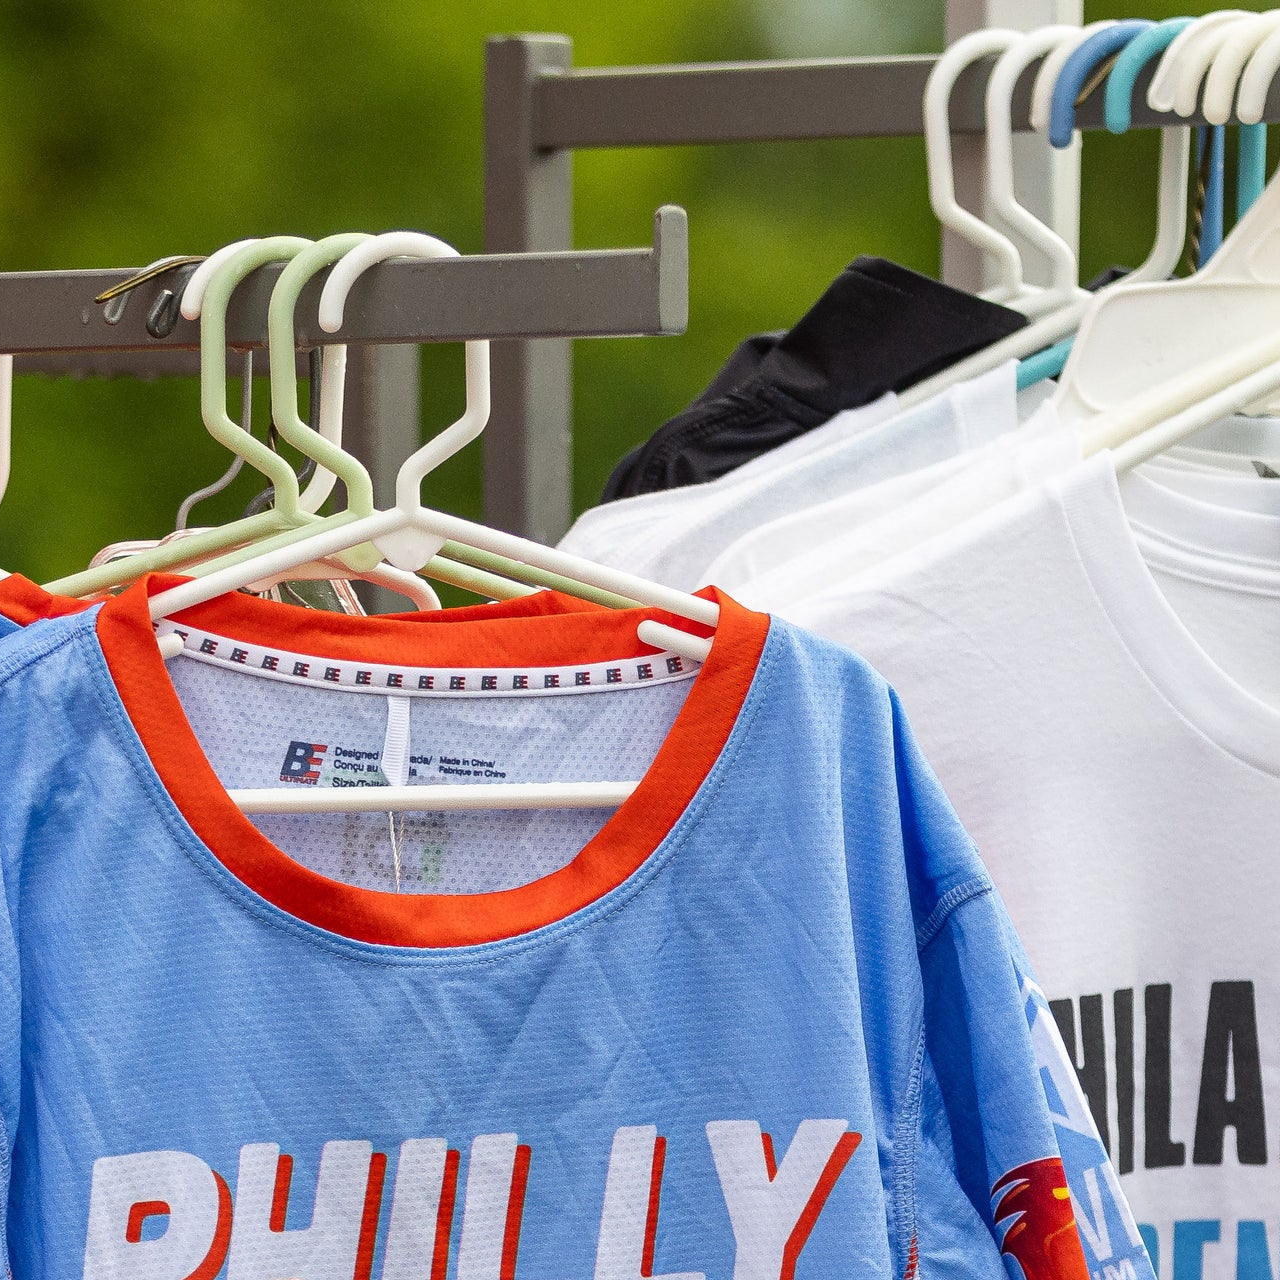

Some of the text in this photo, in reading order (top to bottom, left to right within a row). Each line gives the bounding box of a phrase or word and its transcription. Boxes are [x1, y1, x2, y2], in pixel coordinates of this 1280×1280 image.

[199, 638, 683, 690] BE BE BE BE BE BE BE BE BE BE BE BE BE BE BE BE
[280, 741, 328, 779] BE
[334, 746, 432, 765] Designed ada/
[439, 756, 461, 765] Made
[471, 759, 495, 768] China/
[333, 759, 379, 773] Conçu au
[438, 766, 471, 776] Fabrique
[484, 769, 507, 778] Chine
[279, 775, 318, 785] ULTIMATE
